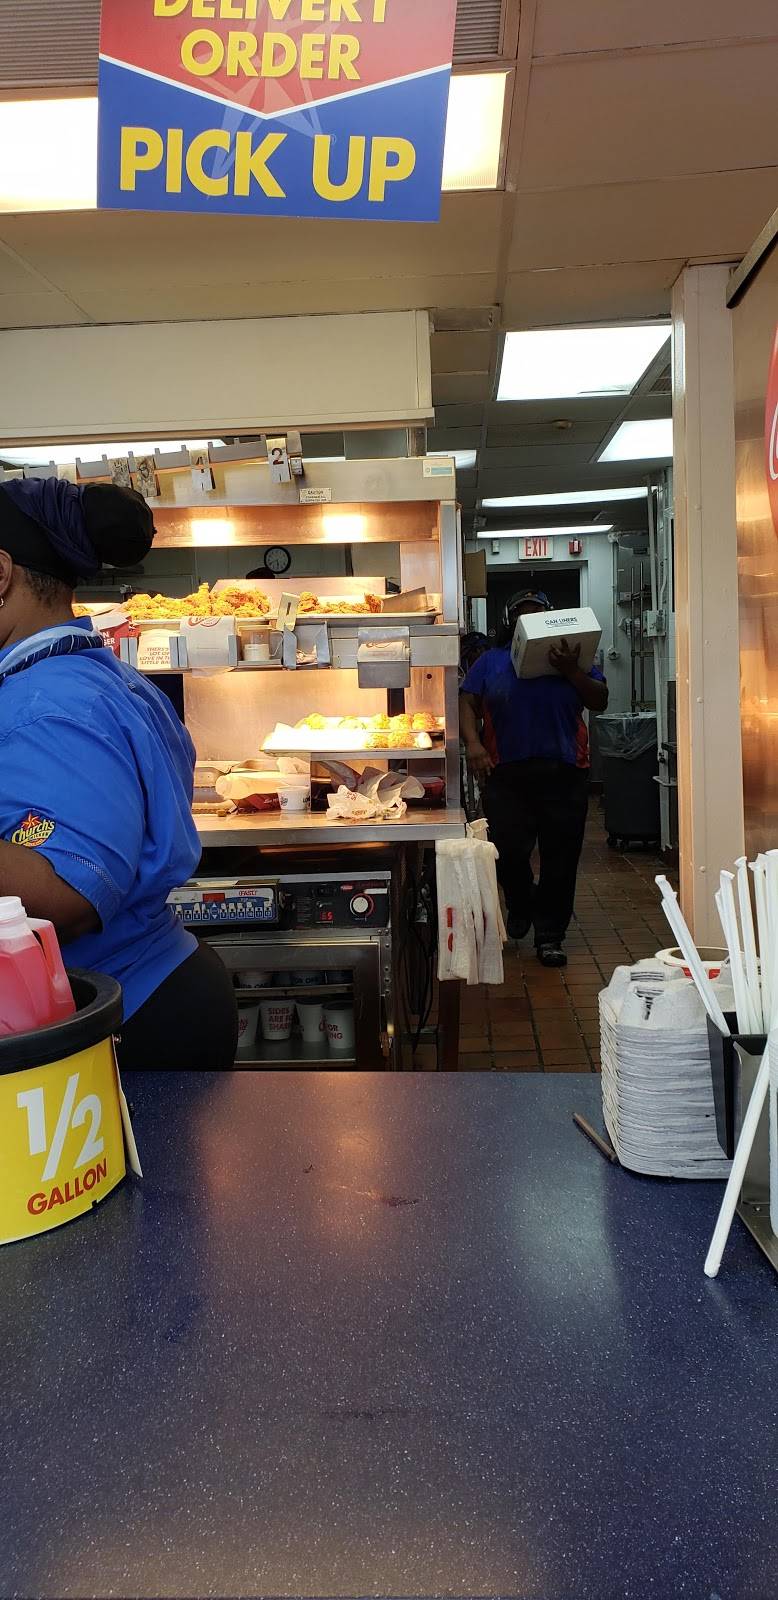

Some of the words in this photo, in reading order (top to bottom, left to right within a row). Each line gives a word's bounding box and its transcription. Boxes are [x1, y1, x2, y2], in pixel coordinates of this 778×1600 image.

[180, 28, 360, 80] ORDER
[120, 126, 286, 198] PICK
[312, 134, 416, 202] UP
[272, 447, 284, 465] 2
[525, 538, 548, 557] EXIT
[12, 819, 55, 845] Church's
[17, 1072, 104, 1182] 1/2
[27, 1158, 107, 1215] GALLON
